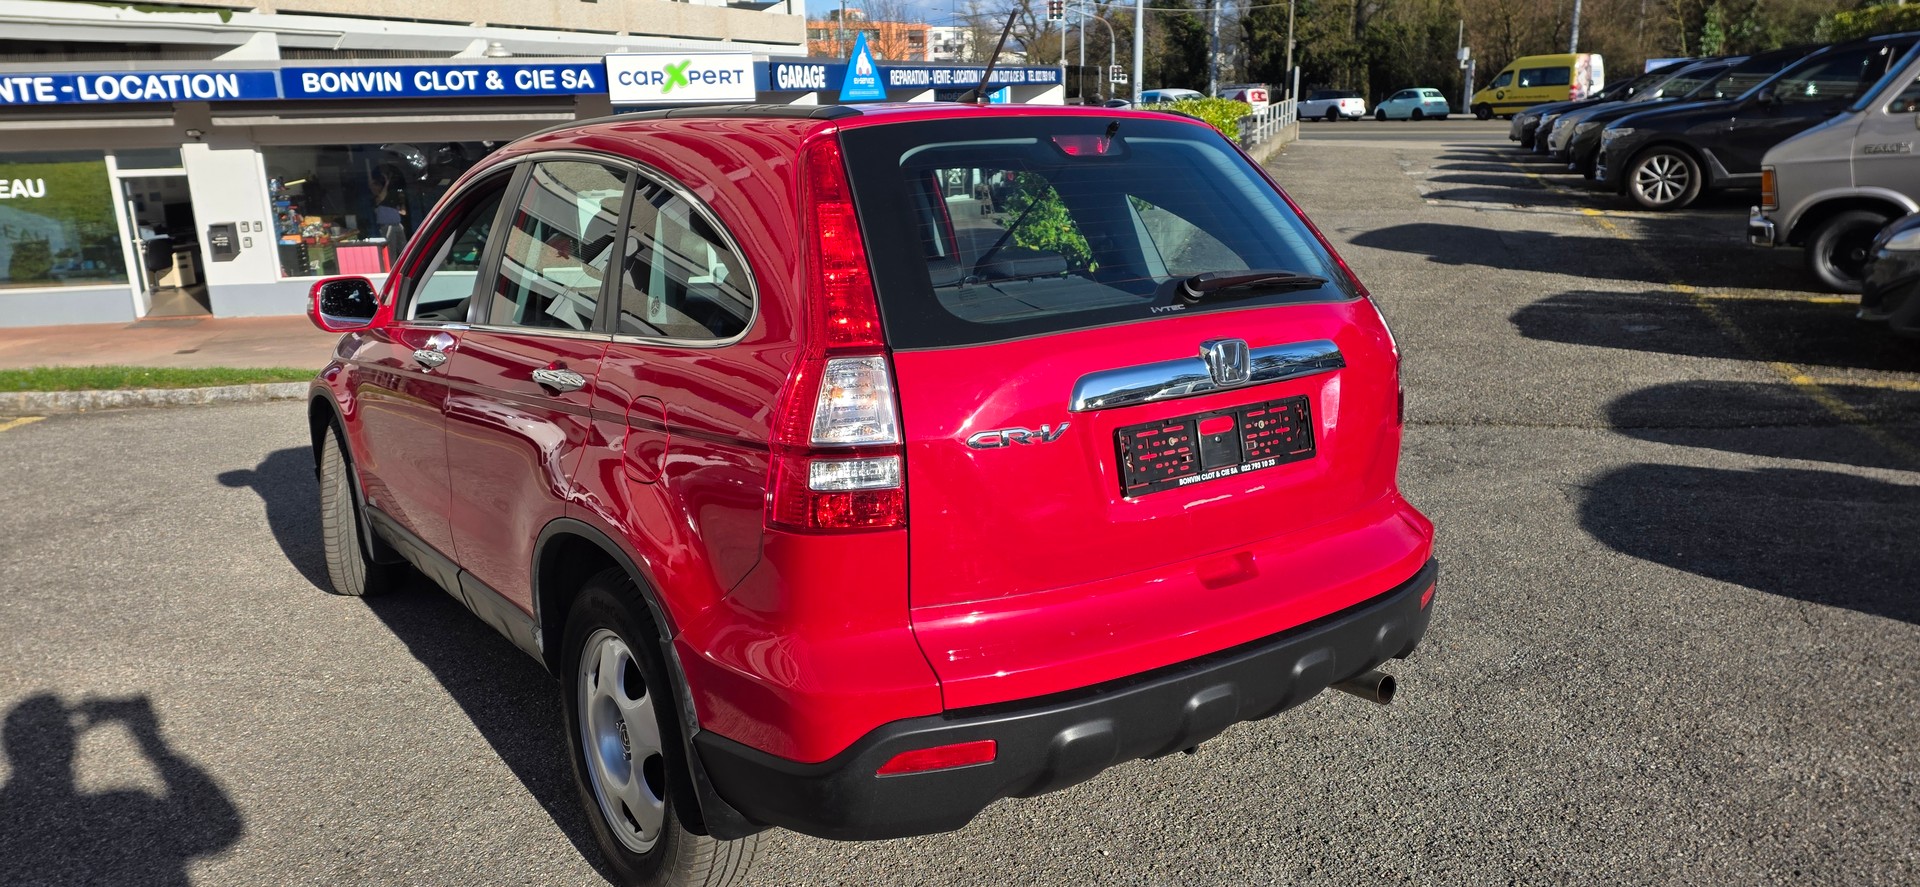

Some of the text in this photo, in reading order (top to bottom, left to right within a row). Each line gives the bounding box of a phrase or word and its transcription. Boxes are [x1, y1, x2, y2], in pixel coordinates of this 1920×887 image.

[302, 68, 595, 93] BONVIN CLOT & CIE SA
[777, 64, 826, 89] GARAGE
[890, 70, 929, 85] REPARATION
[0, 178, 46, 198] EAU
[966, 422, 1070, 449] CR-V
[1179, 475, 1201, 485] BONVIN
[1241, 464, 1251, 472] 022
